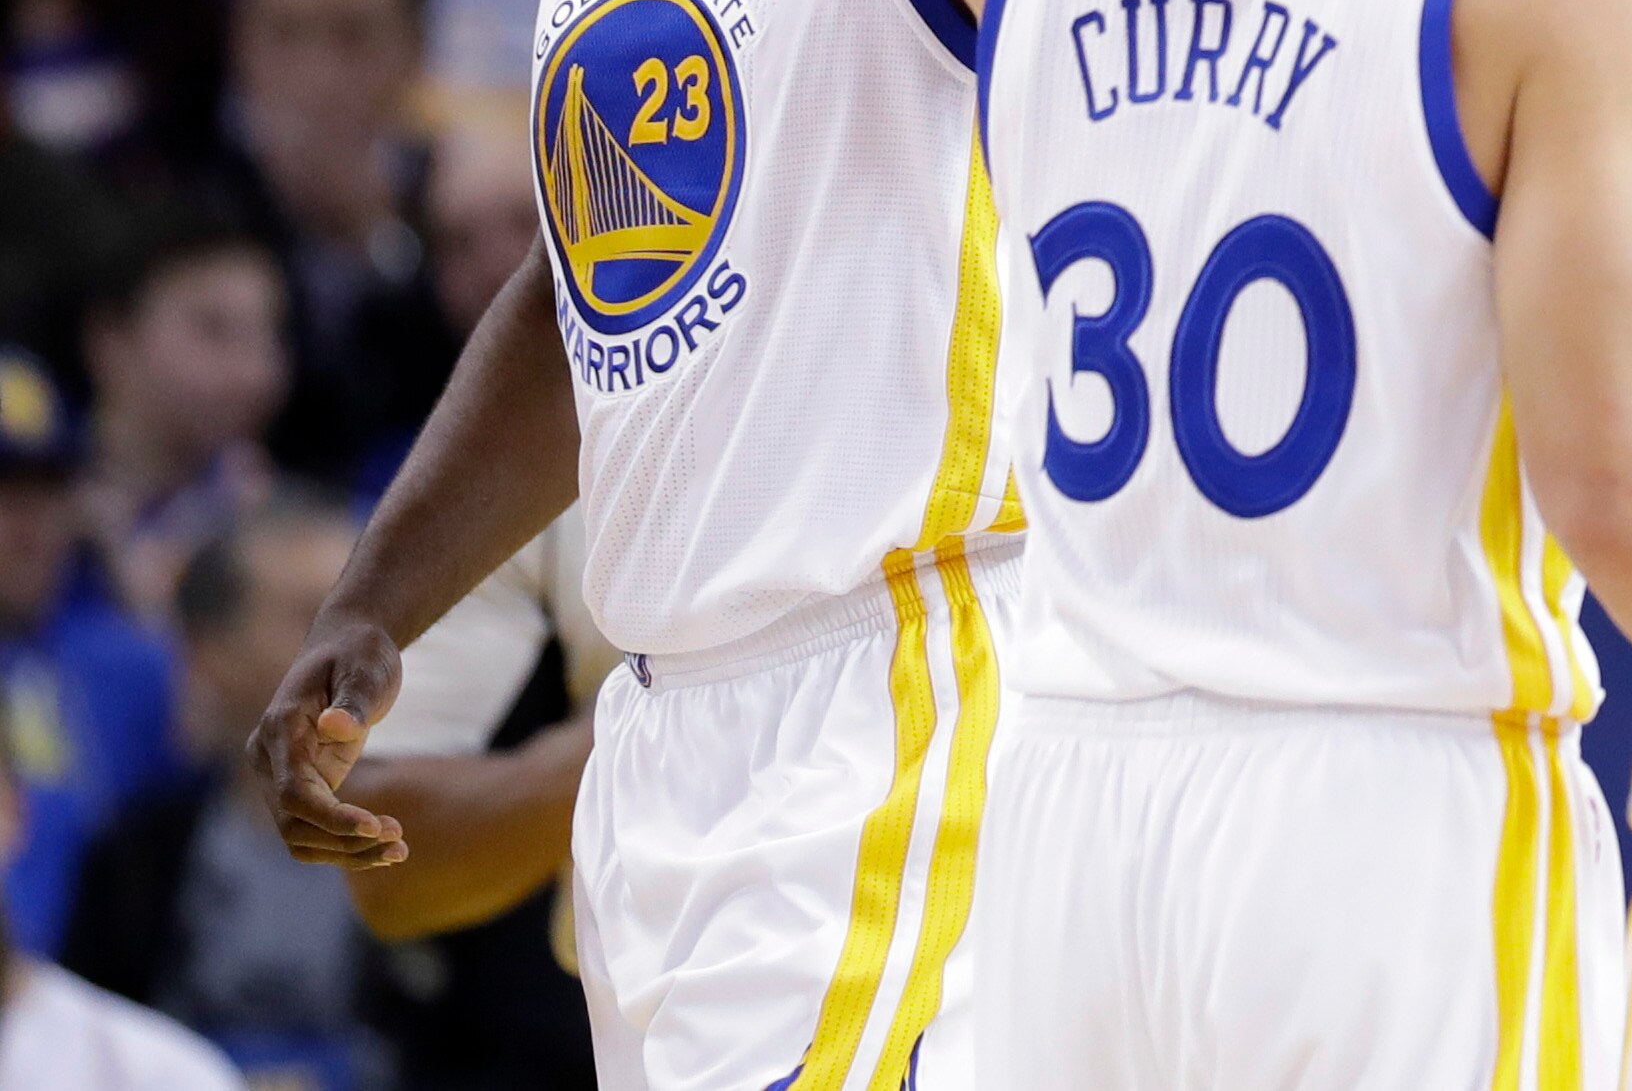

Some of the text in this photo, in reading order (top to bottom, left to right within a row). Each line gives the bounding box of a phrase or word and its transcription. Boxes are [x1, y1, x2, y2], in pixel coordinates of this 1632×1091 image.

[628, 55, 712, 147] 23
[556, 258, 748, 393] WARRIORS
[1027, 200, 1358, 520] 30
